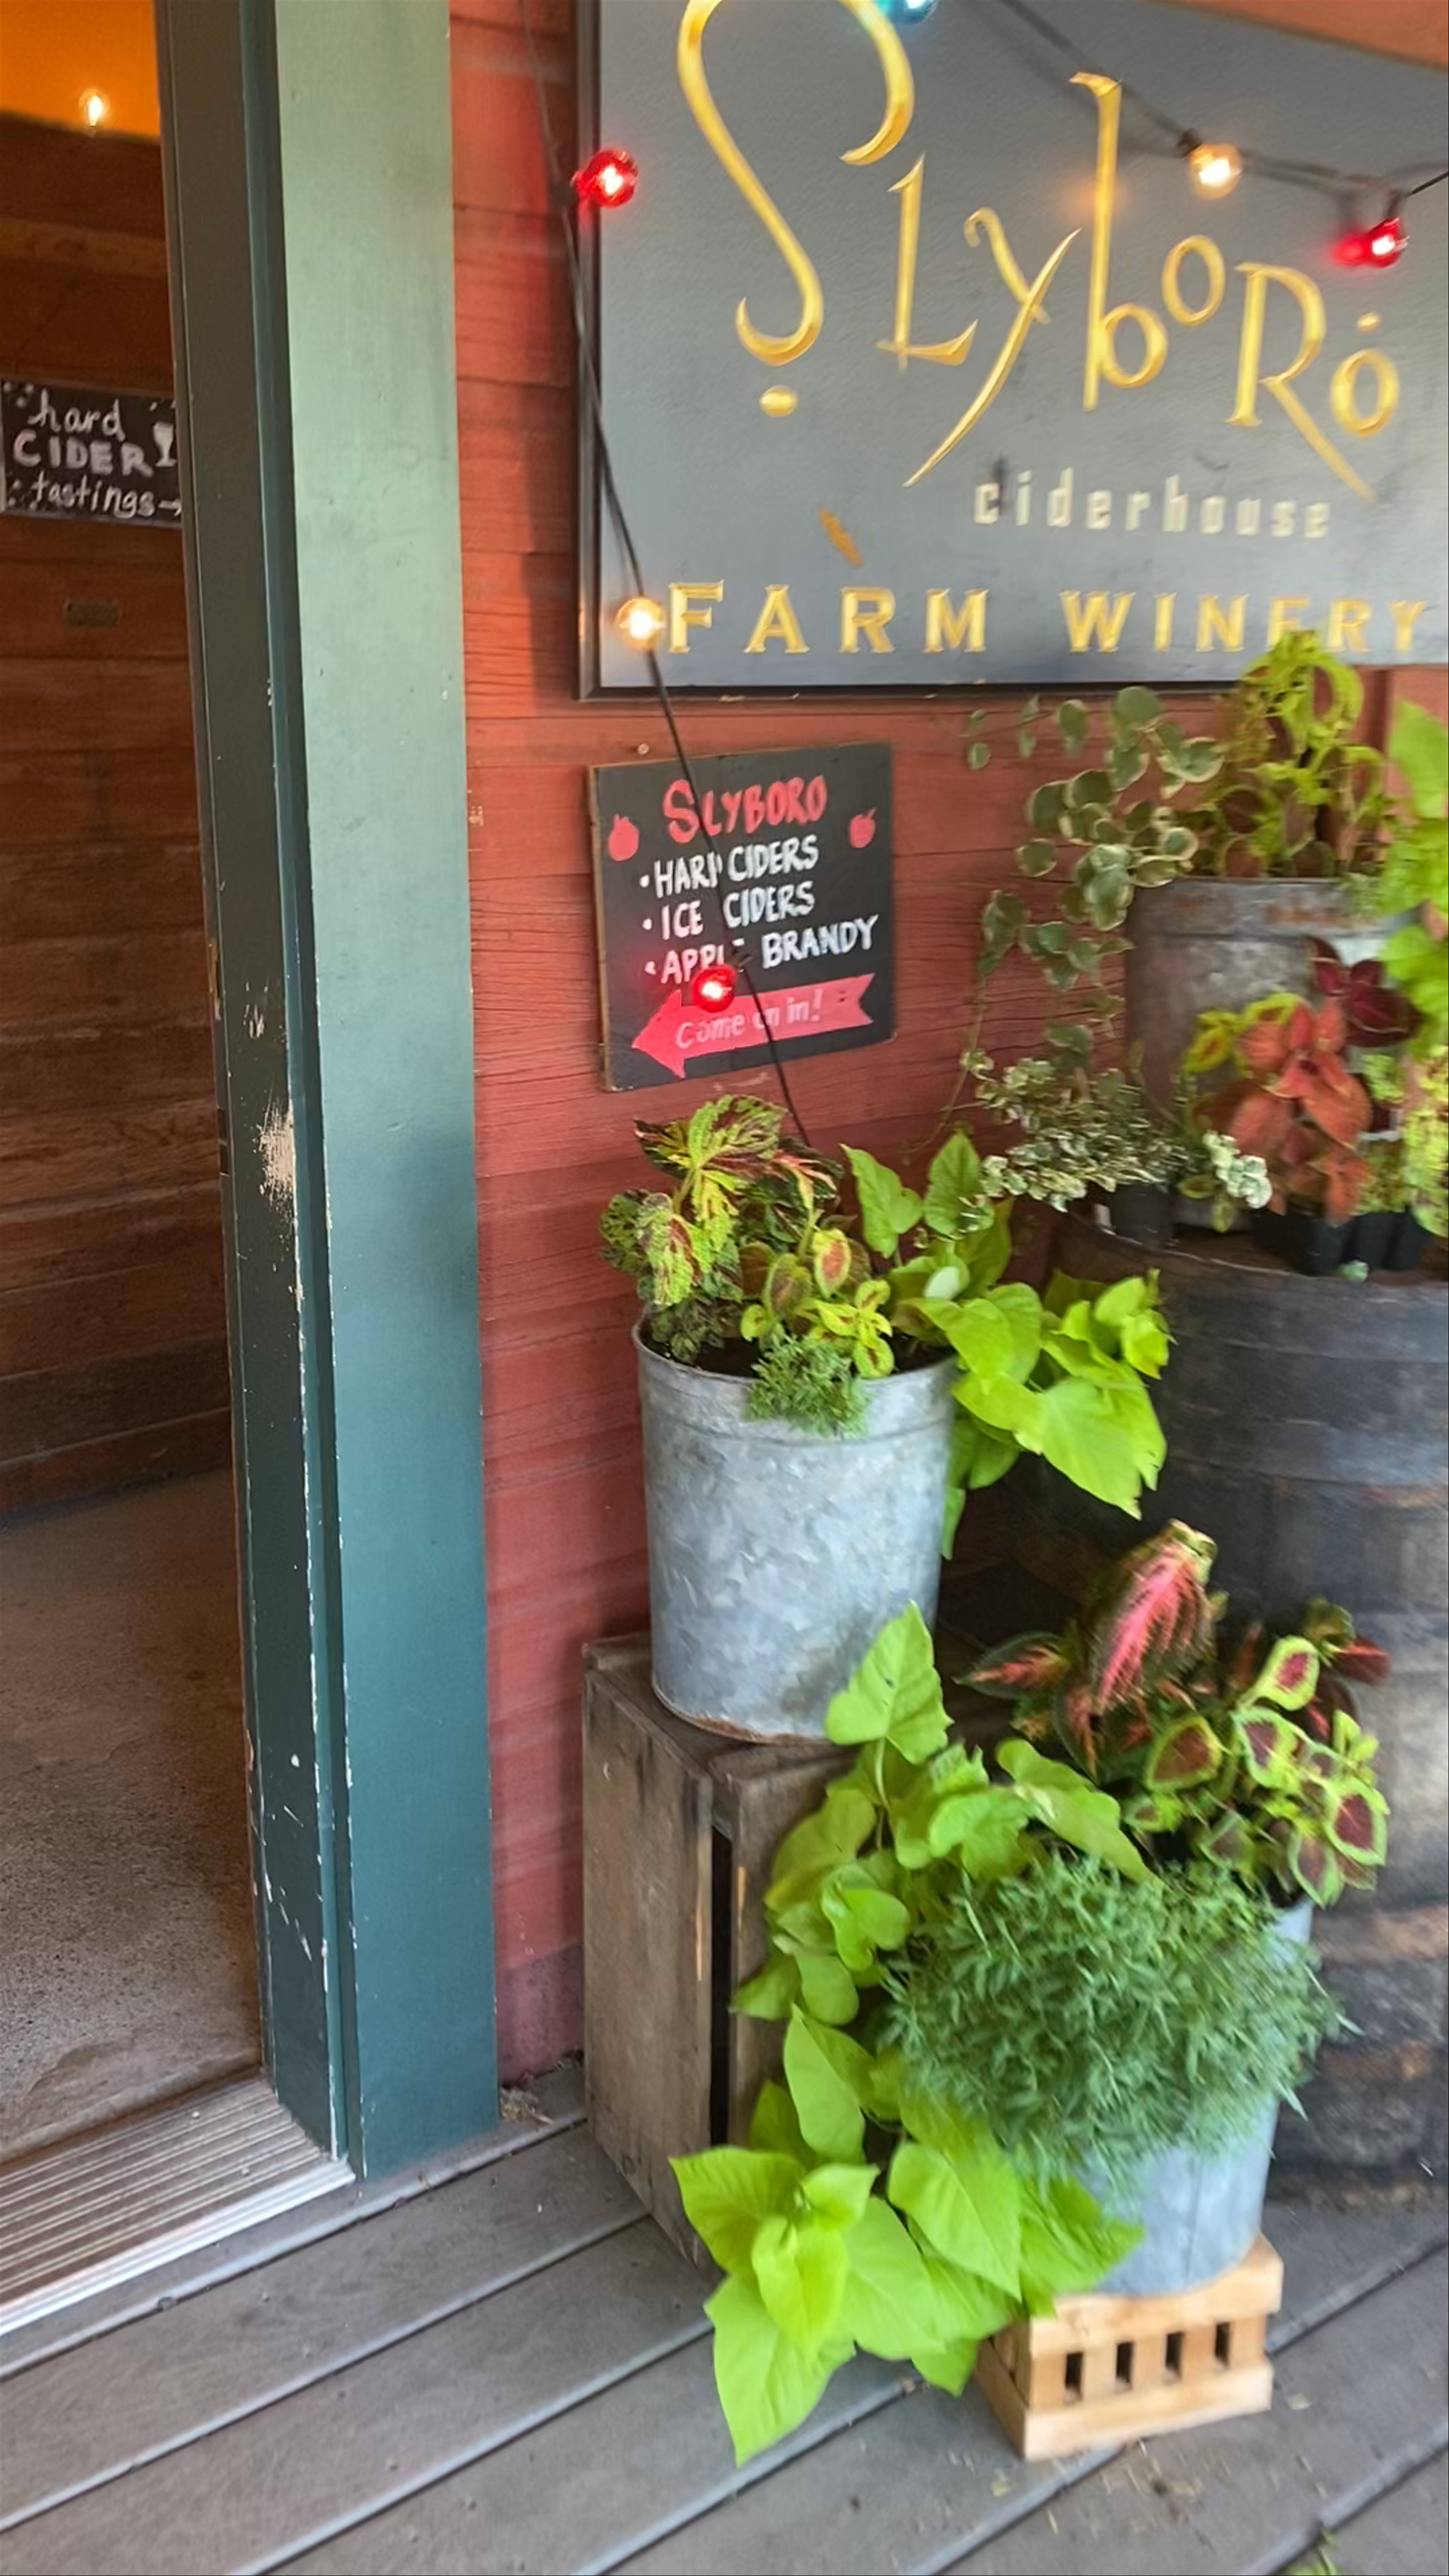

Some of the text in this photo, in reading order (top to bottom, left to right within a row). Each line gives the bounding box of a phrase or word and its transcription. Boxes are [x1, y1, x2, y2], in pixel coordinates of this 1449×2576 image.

[27, 388, 126, 441] hard
[13, 429, 154, 477] CIDER
[31, 470, 155, 519] tastings
[974, 468, 1331, 538] ciderhouse
[667, 580, 989, 654] FARM
[663, 775, 828, 843] SLYBORO
[728, 834, 820, 882] CIDERS
[661, 881, 815, 940] ICE CIDERS
[761, 914, 879, 968] BRANDY
[676, 1014, 745, 1049] Come
[786, 988, 823, 1023] in!
